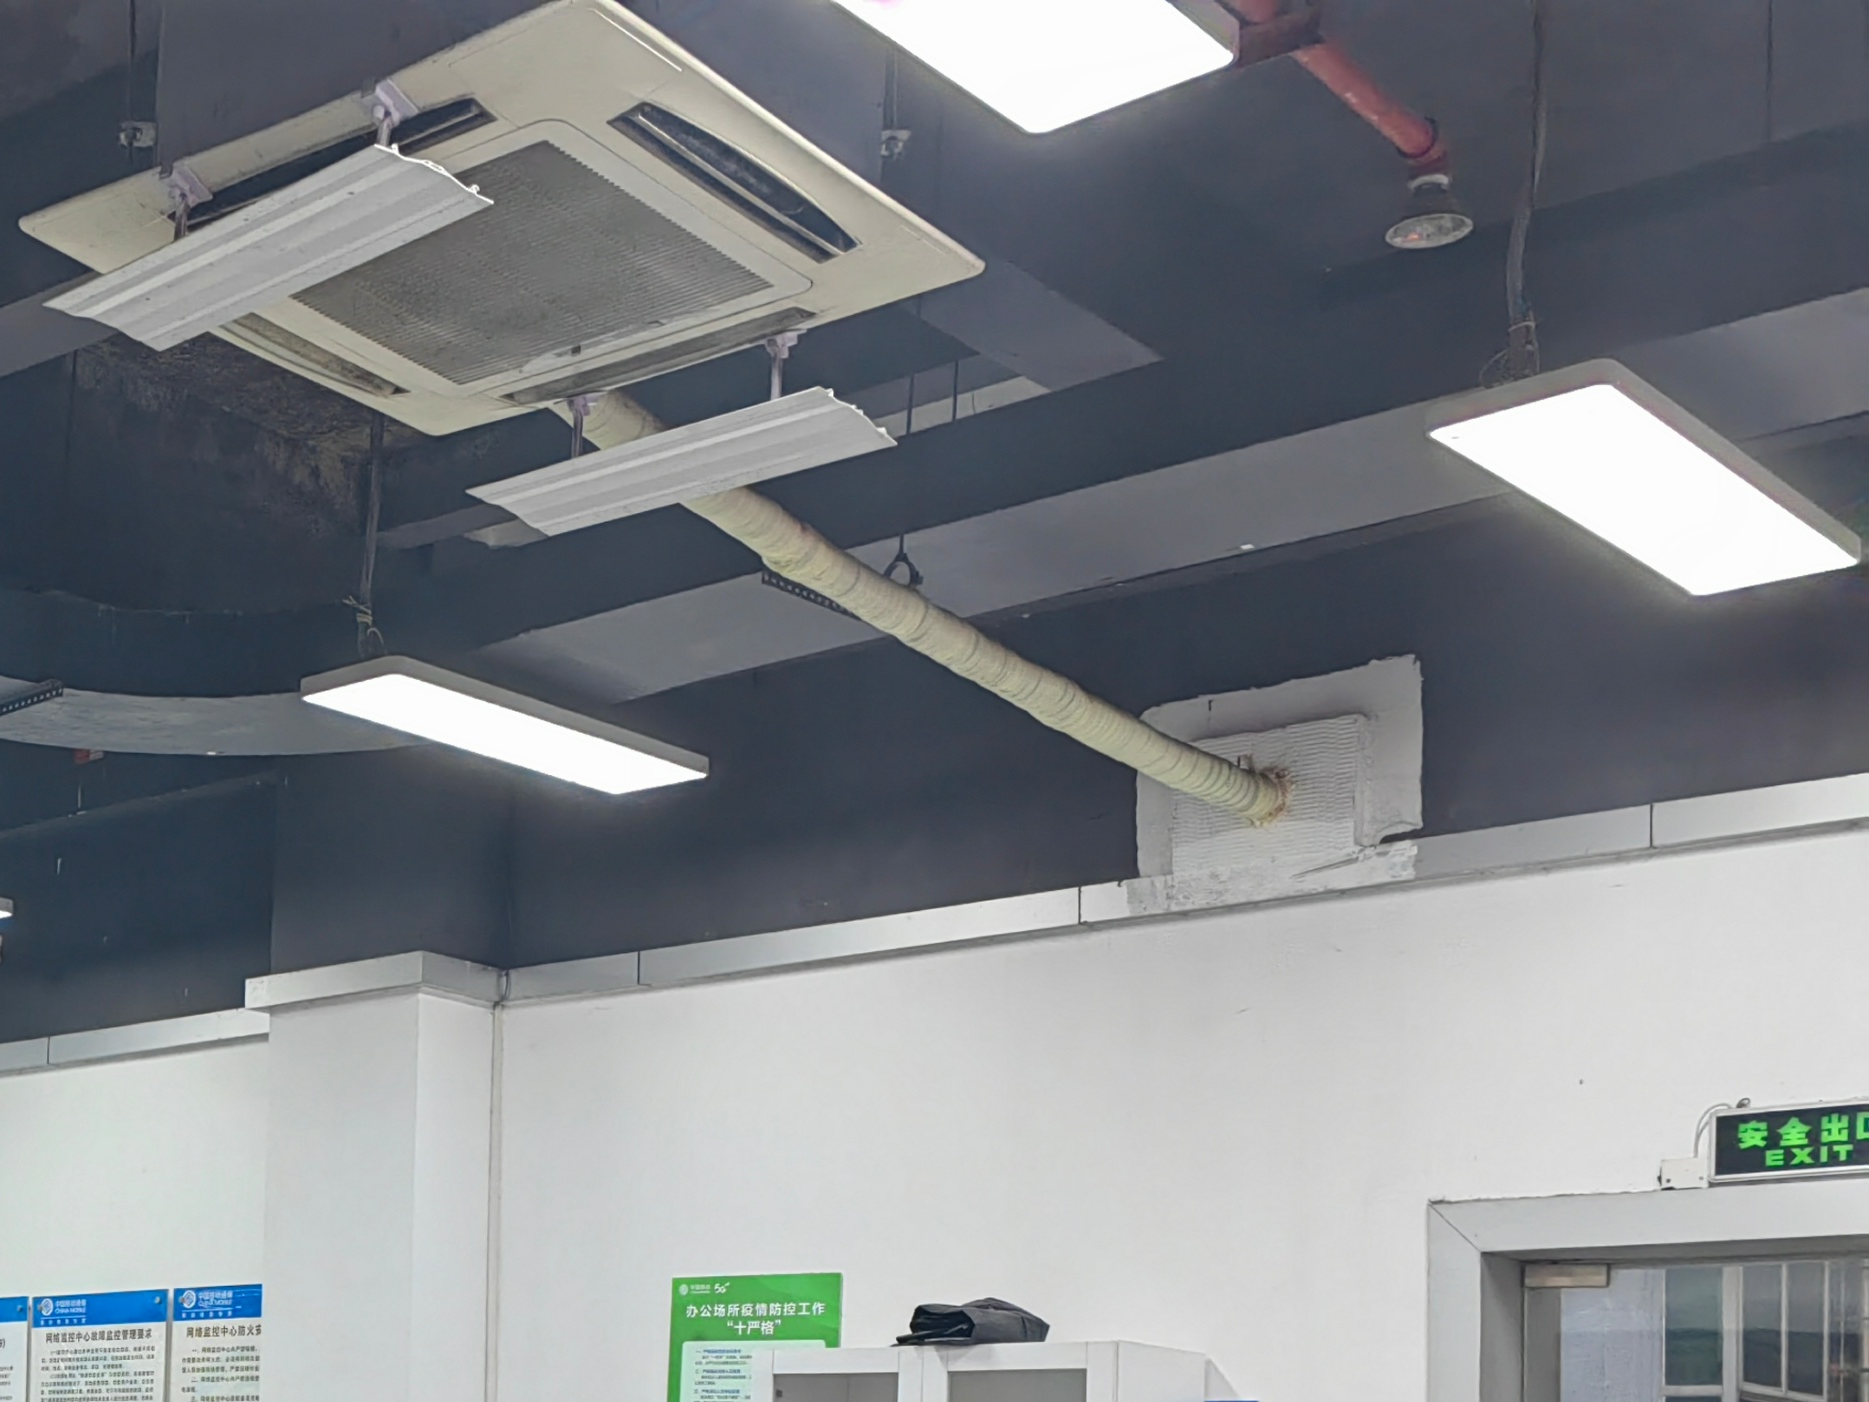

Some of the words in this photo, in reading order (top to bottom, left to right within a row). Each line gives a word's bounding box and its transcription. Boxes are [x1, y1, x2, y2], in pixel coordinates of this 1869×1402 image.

[1765, 1145, 1854, 1167] EXIT
[686, 1301, 826, 1318] 办公场所疫情防控工作
[727, 1319, 781, 1335] “十严格”
